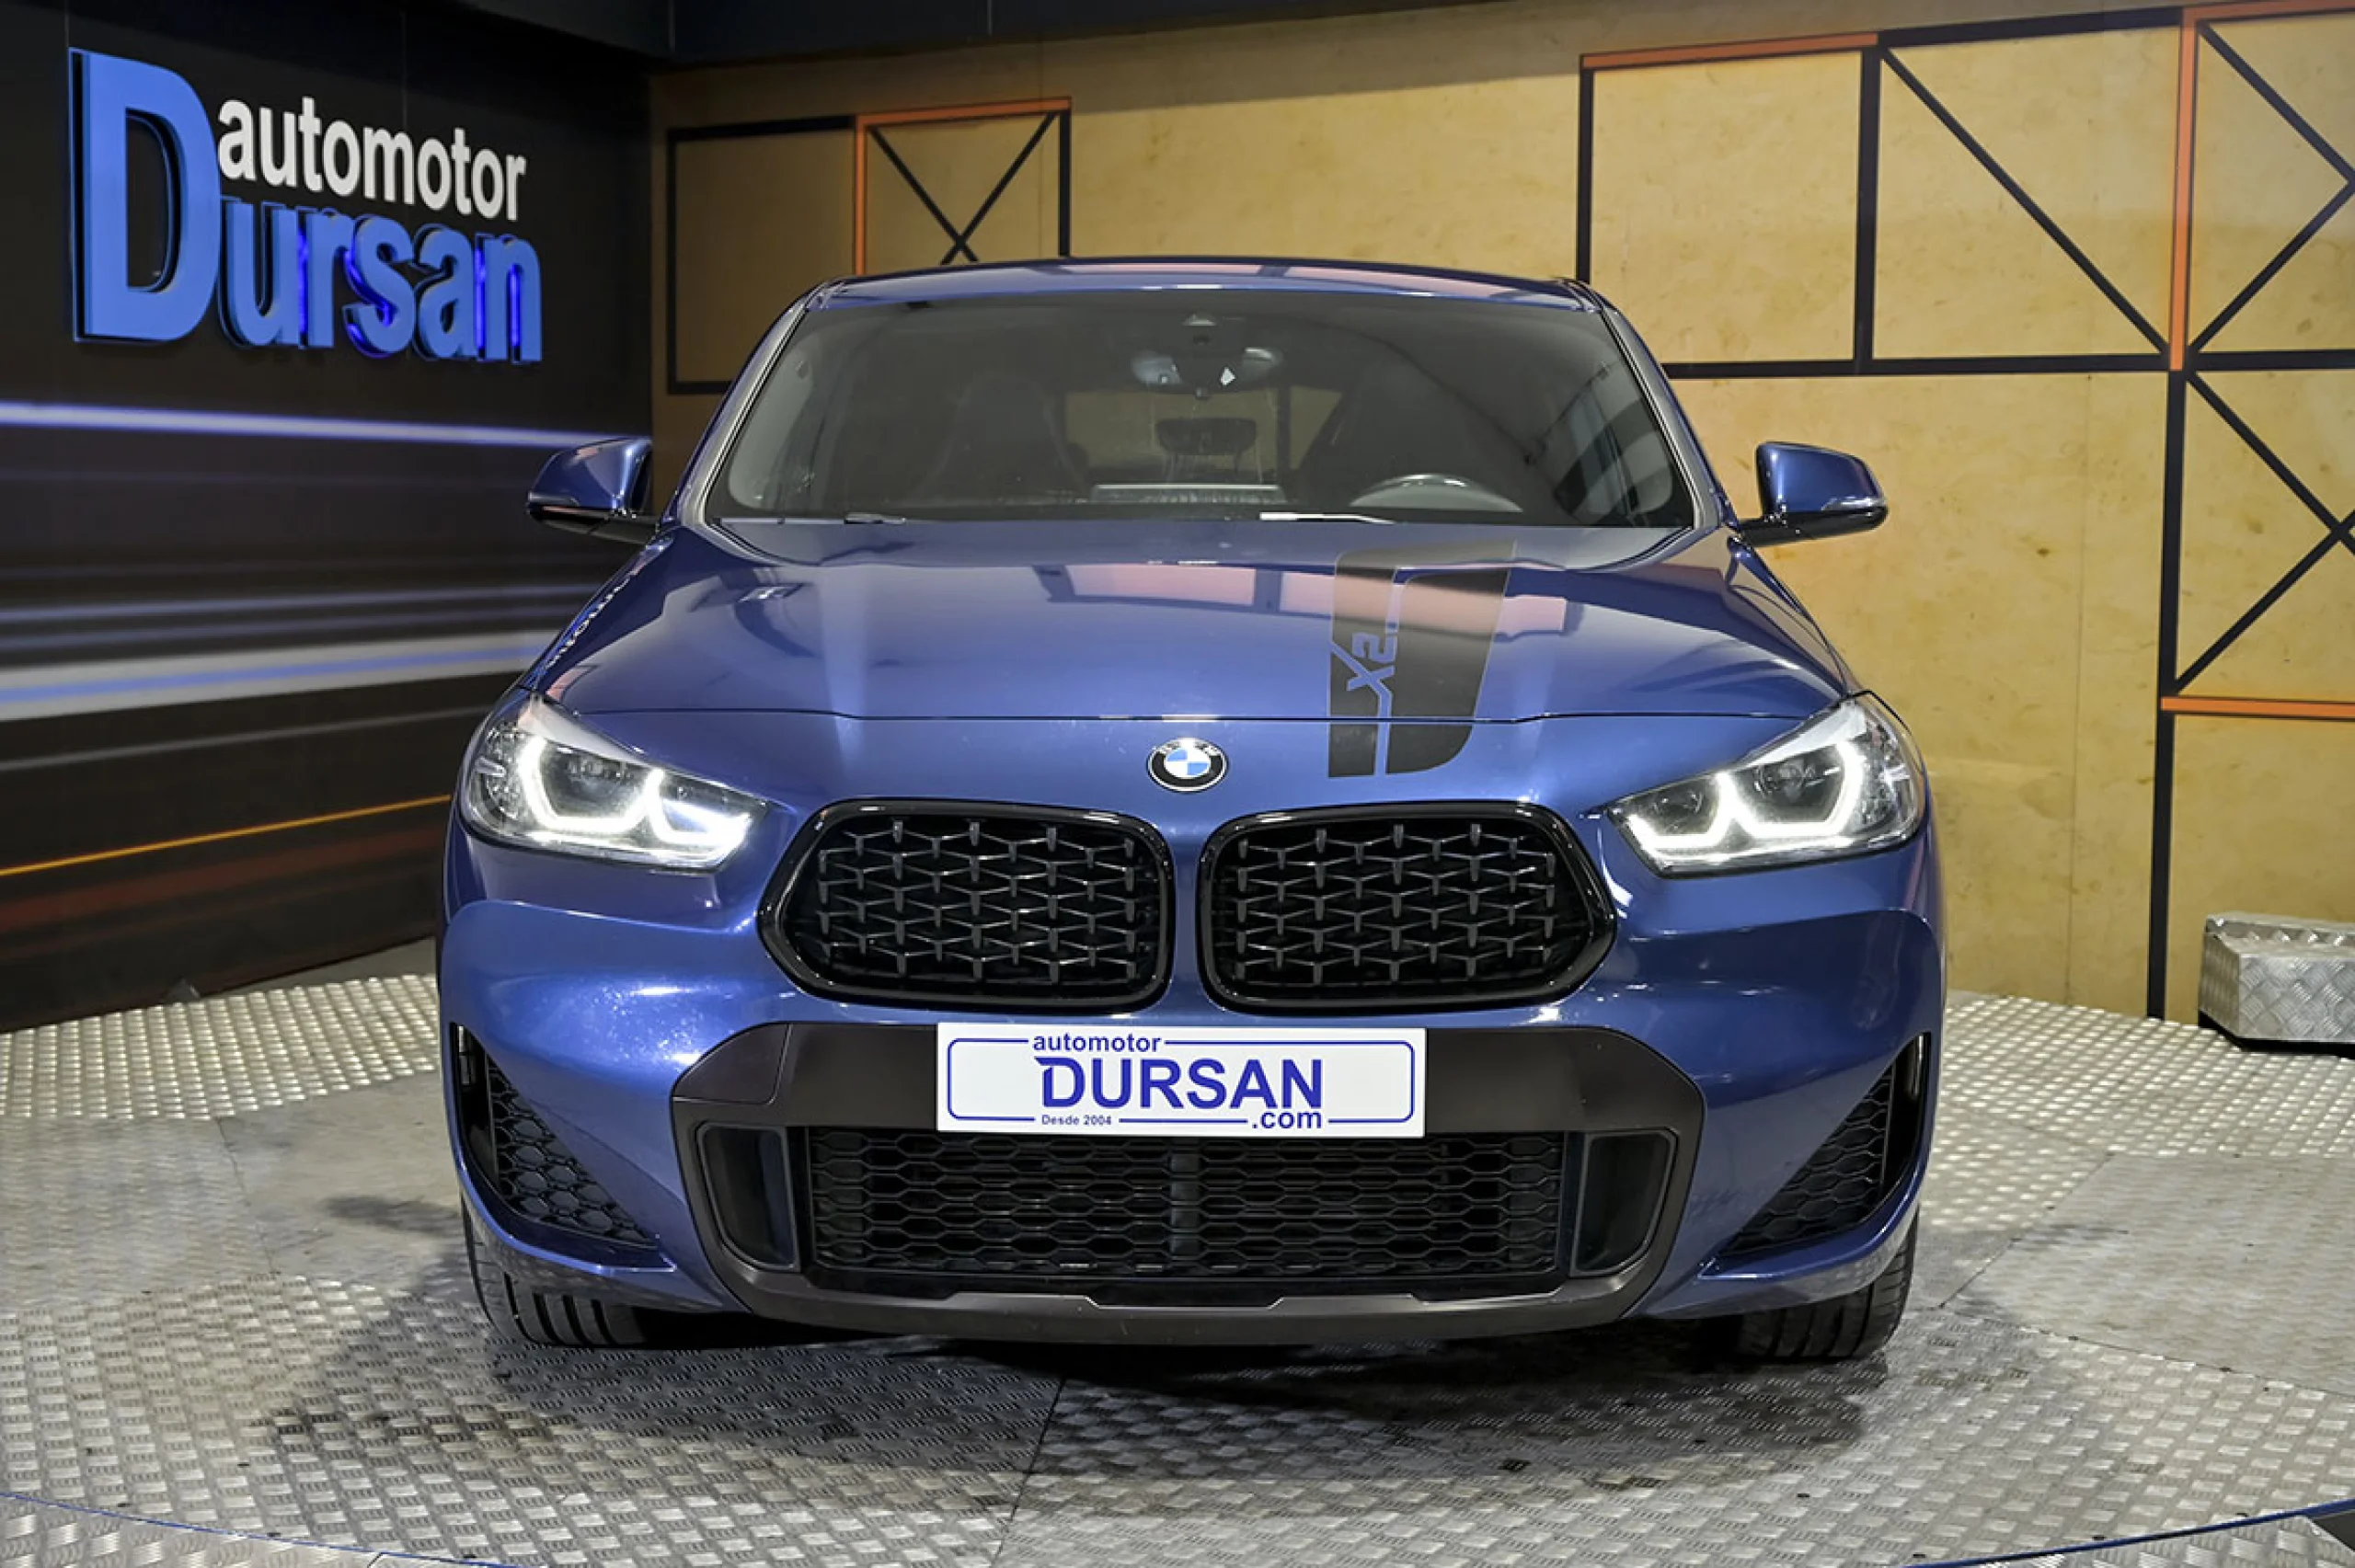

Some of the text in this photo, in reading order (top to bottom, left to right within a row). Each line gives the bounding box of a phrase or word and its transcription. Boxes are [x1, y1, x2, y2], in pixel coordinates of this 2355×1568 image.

[217, 96, 527, 222] automotor
[69, 47, 543, 364] Dursan
[1032, 1032, 1162, 1053] automotor
[1033, 1056, 1323, 1110] DURSAN
[1041, 1115, 1112, 1126] Desde 2004
[1252, 1111, 1323, 1129] .com
